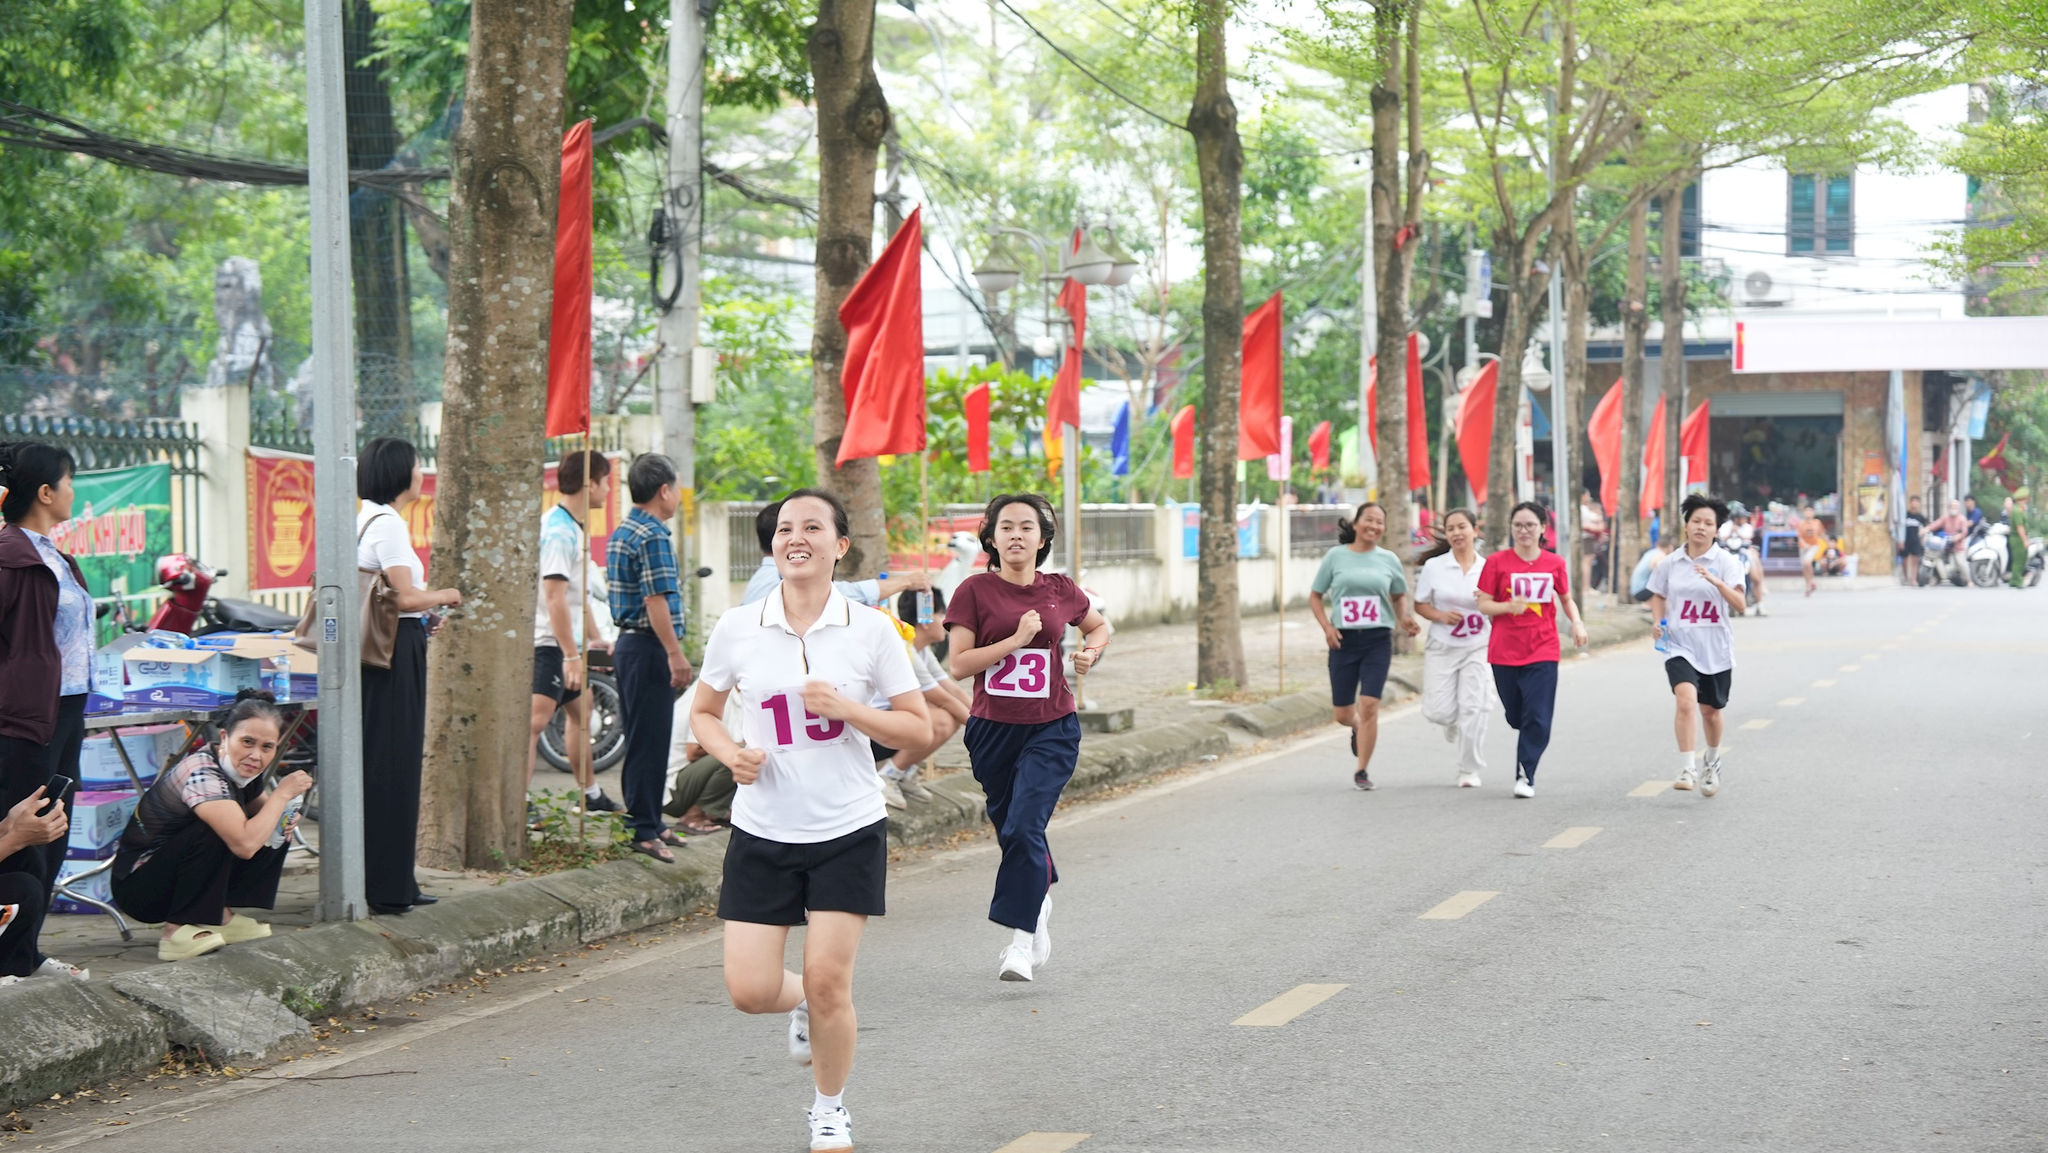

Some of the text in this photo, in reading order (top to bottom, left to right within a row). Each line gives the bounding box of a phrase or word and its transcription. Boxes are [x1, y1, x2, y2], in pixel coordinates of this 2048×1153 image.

[1514, 577, 1549, 600] 07
[1343, 600, 1378, 623] 34
[1680, 600, 1720, 623] 44
[1451, 614, 1484, 638] 29
[988, 653, 1046, 692] 23
